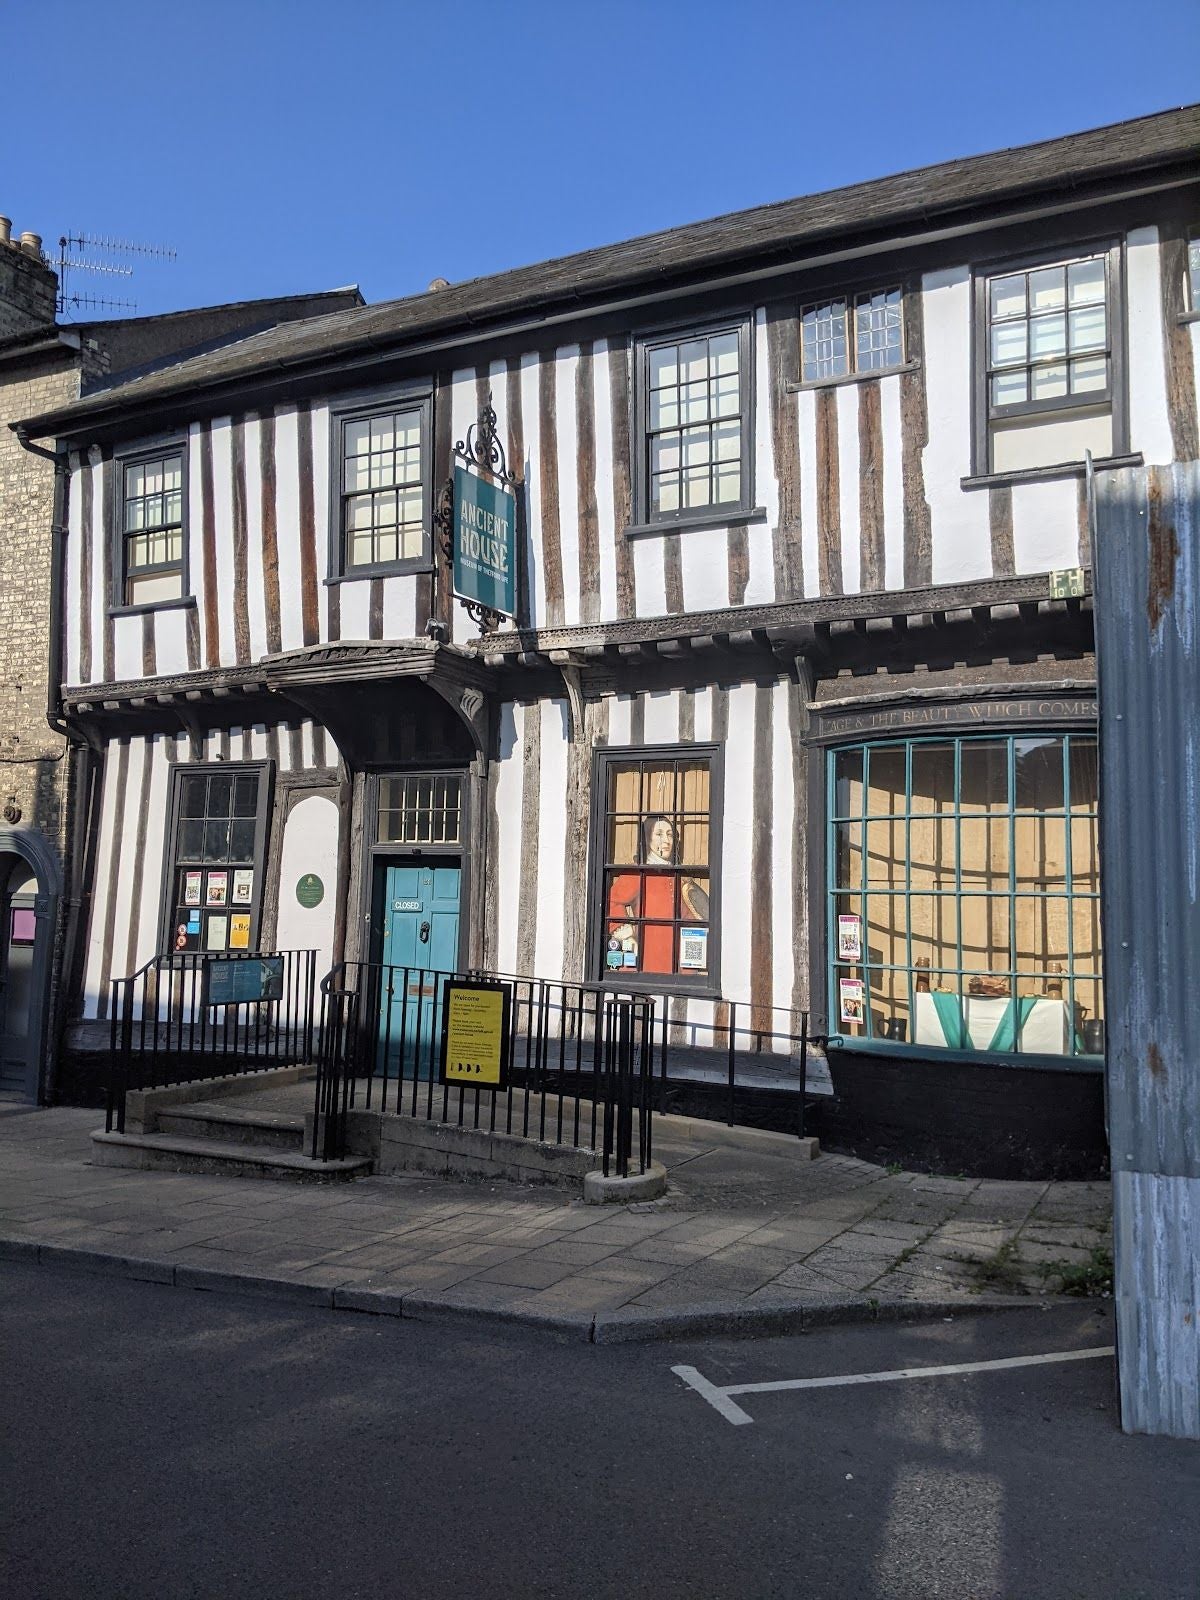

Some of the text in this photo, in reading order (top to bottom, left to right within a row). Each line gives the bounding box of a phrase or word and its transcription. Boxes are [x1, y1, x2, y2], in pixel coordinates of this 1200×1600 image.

[460, 499, 509, 541] ANCIENT
[460, 525, 509, 573] HOUSE
[1053, 569, 1081, 588] FH
[855, 716, 865, 728] &
[903, 706, 963, 723] BEAUTY
[969, 702, 1033, 718] WHICH
[1038, 701, 1098, 717] COMES
[394, 901, 420, 910] CLOSED
[453, 993, 480, 1003] Welcome
